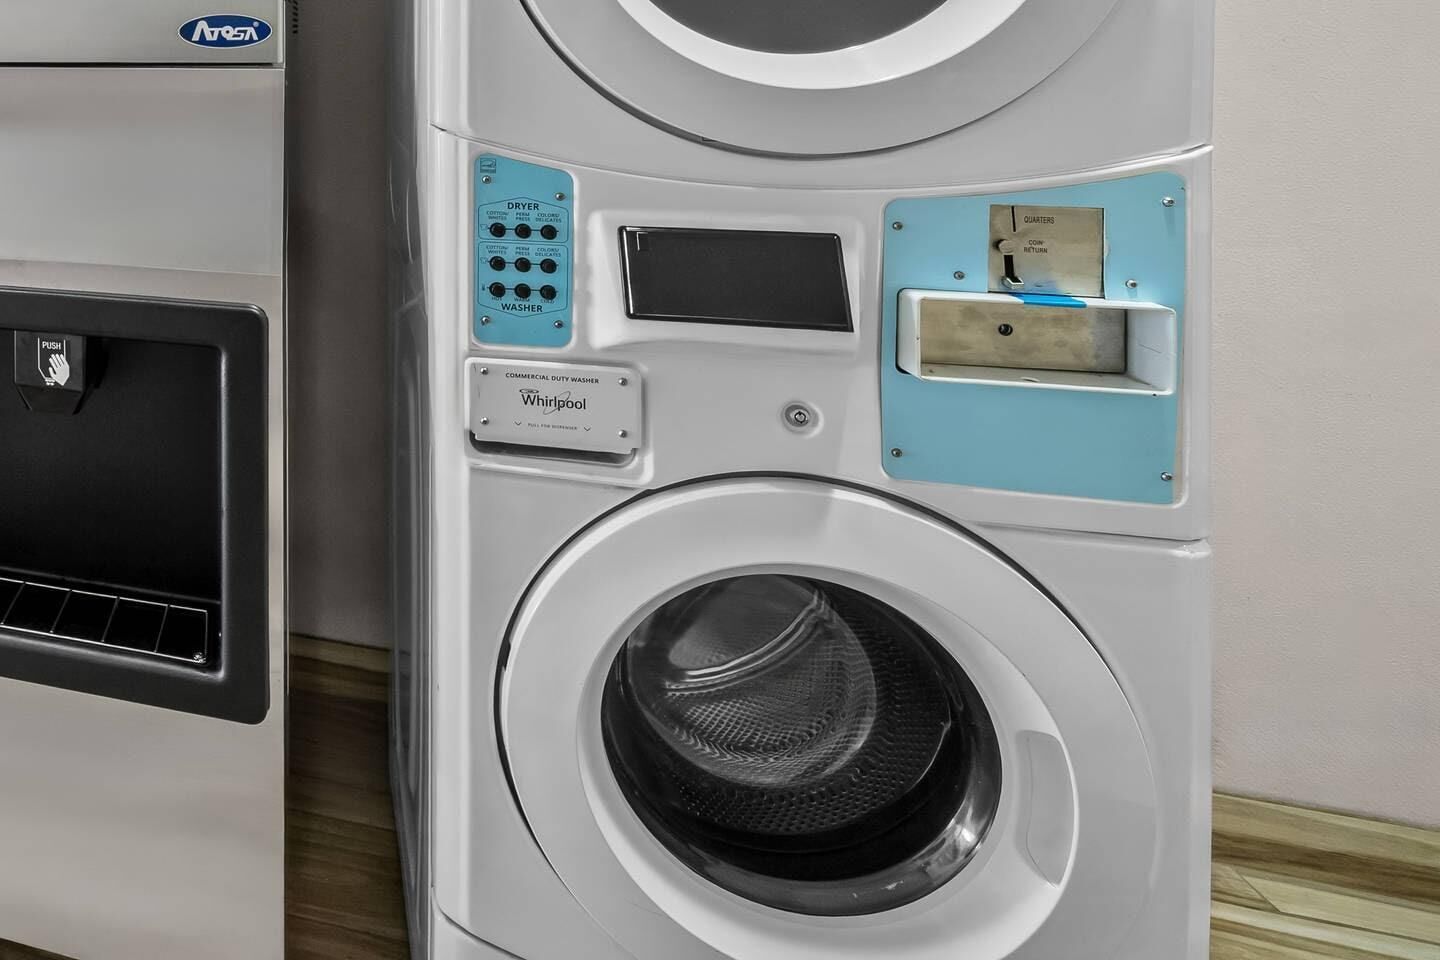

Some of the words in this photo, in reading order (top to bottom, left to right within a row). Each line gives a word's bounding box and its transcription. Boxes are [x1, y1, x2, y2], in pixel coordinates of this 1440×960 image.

[507, 202, 539, 210] DRYER
[1024, 216, 1055, 224] QUARTERS
[501, 303, 543, 312] WASHER
[42, 341, 61, 350] PUSH
[522, 394, 586, 411] Whirlpool
